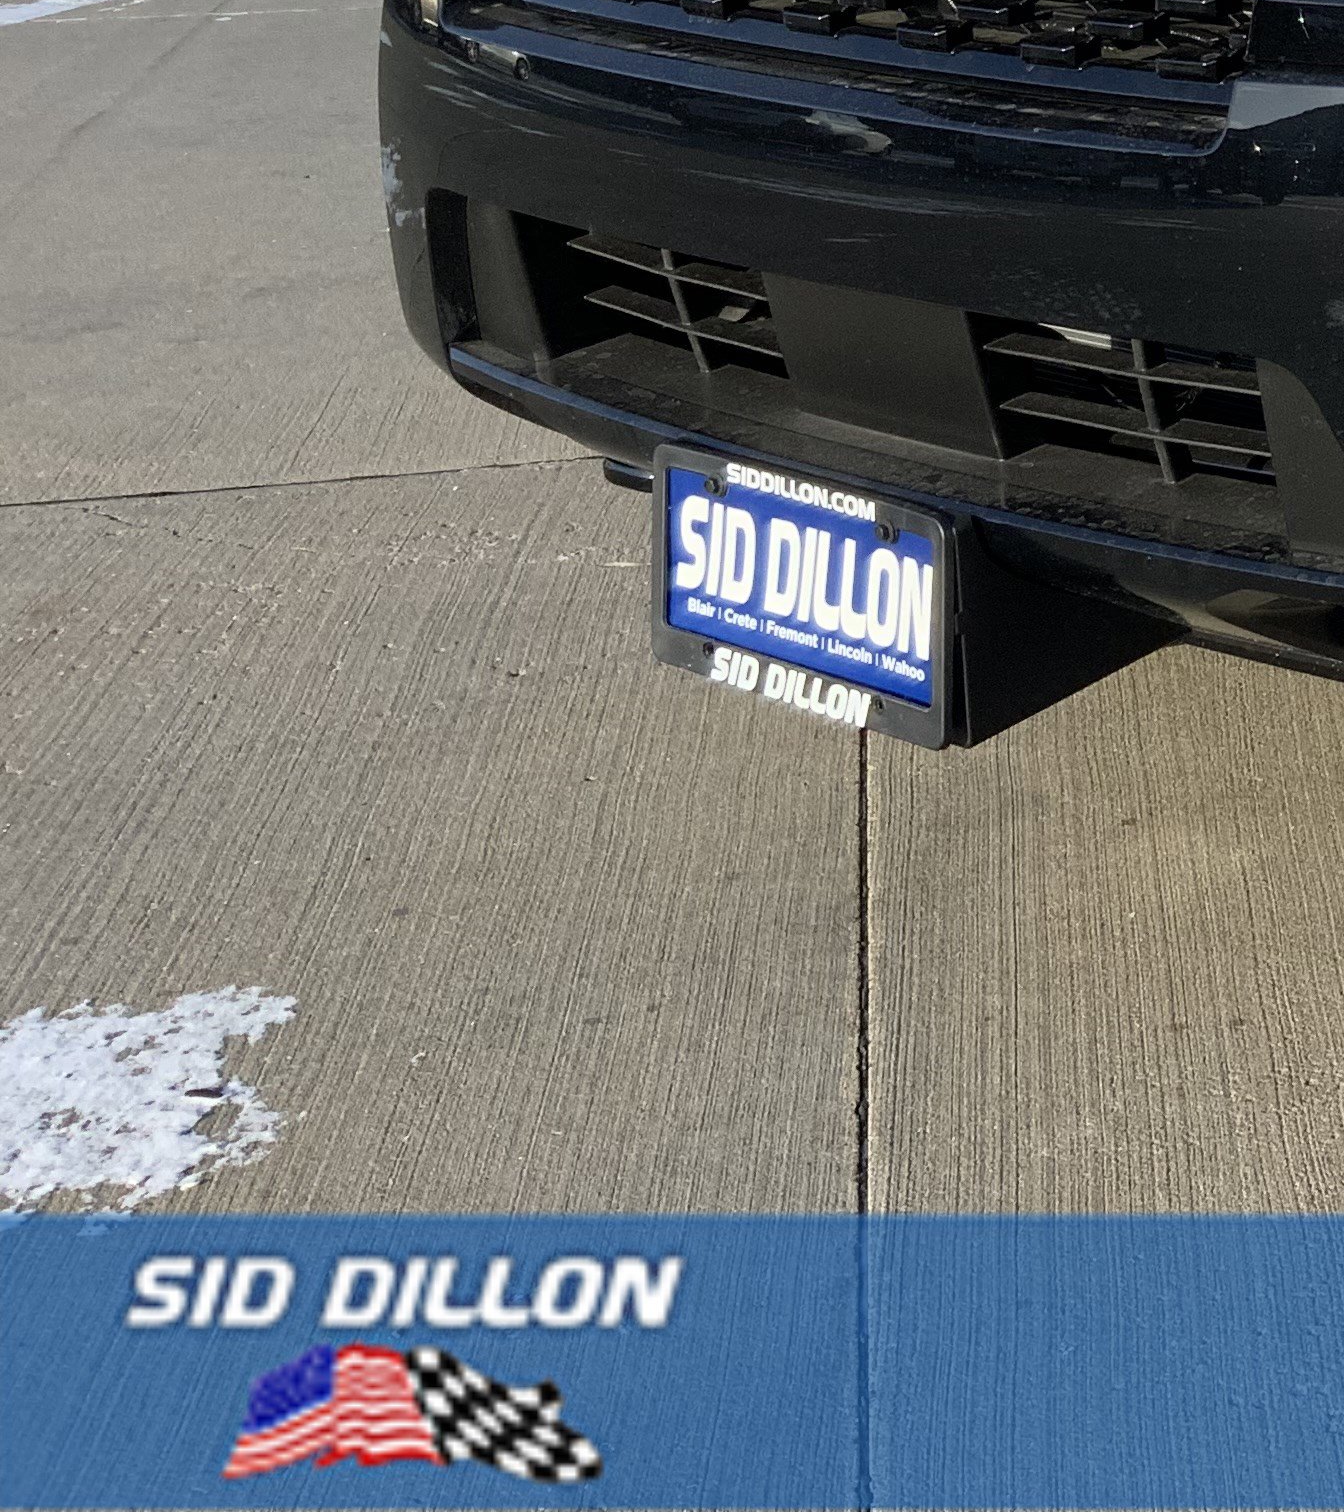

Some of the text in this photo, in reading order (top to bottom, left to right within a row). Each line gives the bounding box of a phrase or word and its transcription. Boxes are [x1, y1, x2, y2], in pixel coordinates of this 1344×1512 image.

[726, 462, 876, 522] SIDDILLON.COM
[676, 495, 934, 661] SID DILLON
[687, 597, 926, 682] Blair Crete Fremont Lincoln Wahoo
[710, 646, 872, 728] SID DILLON
